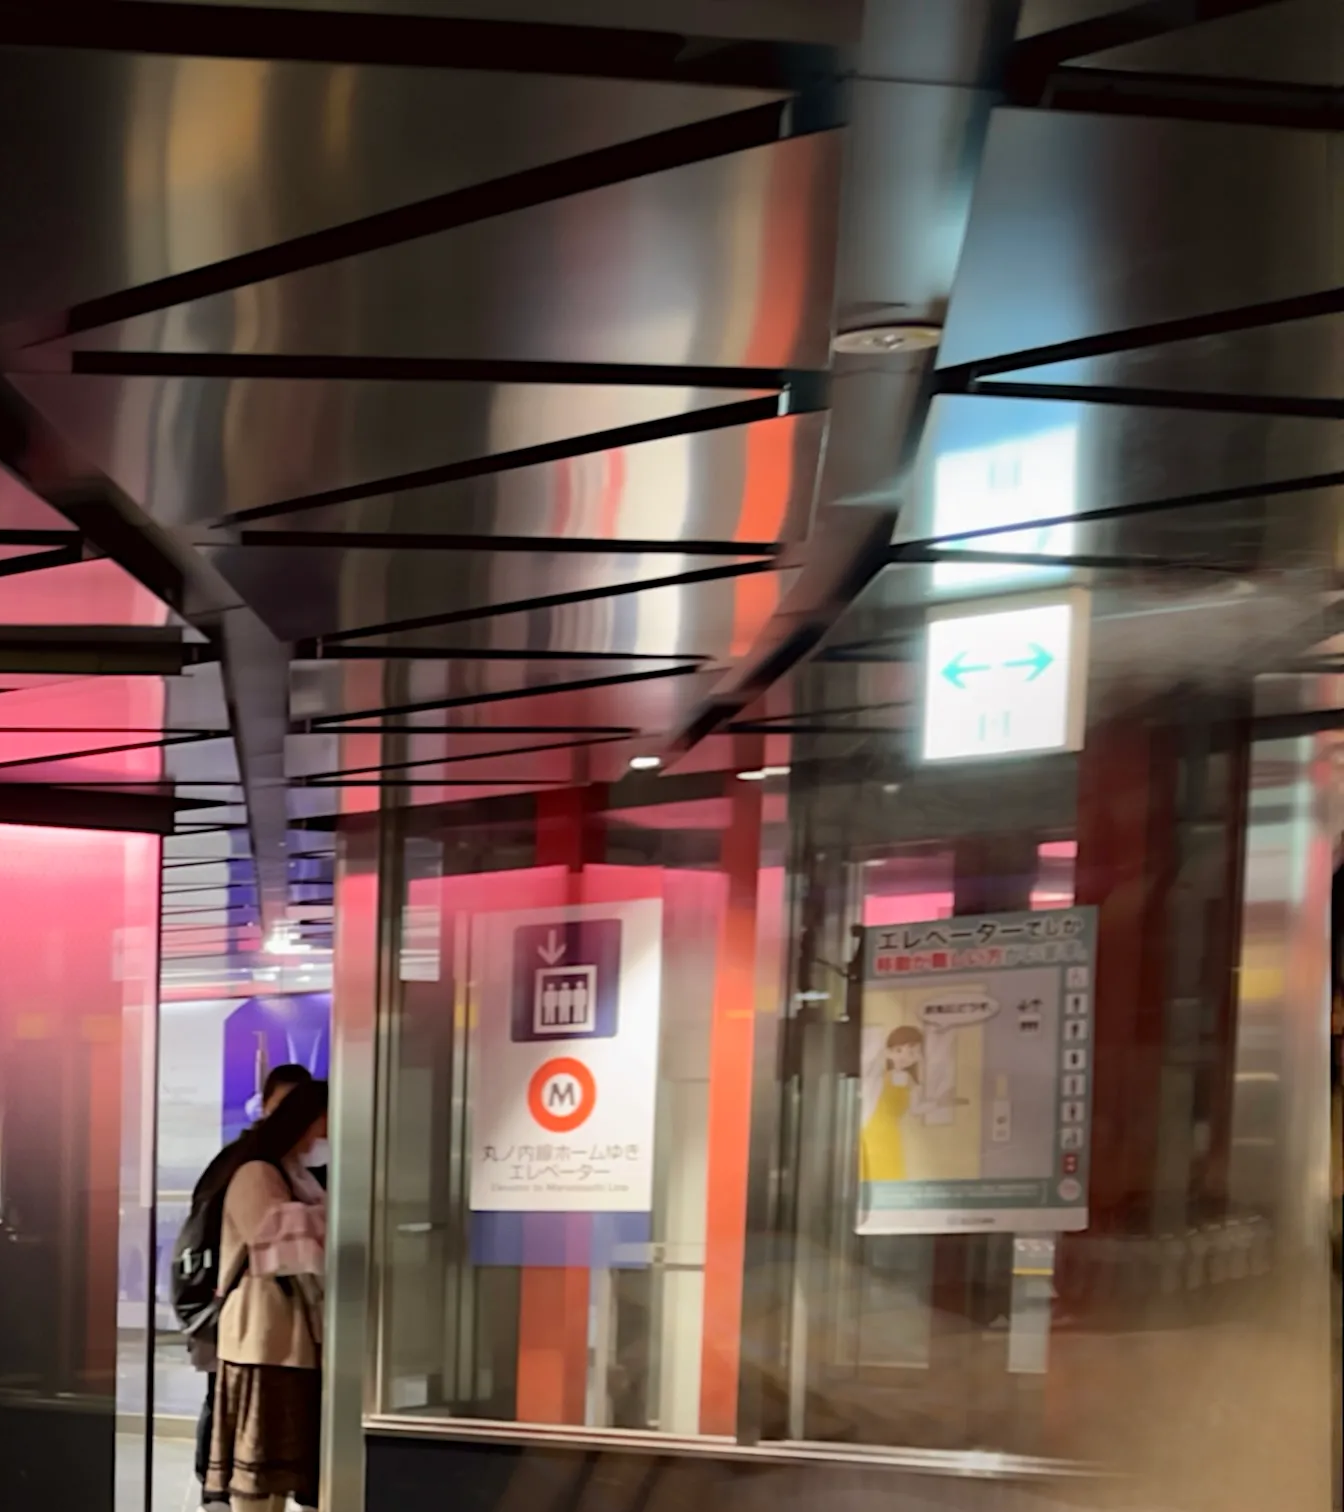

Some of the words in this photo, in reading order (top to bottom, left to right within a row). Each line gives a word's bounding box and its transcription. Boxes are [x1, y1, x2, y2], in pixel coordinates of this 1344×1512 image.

[548, 1082, 575, 1107] M
[482, 1143, 640, 1162] 丸ノ内線ホームゆき
[509, 1163, 611, 1181] エレベーター
